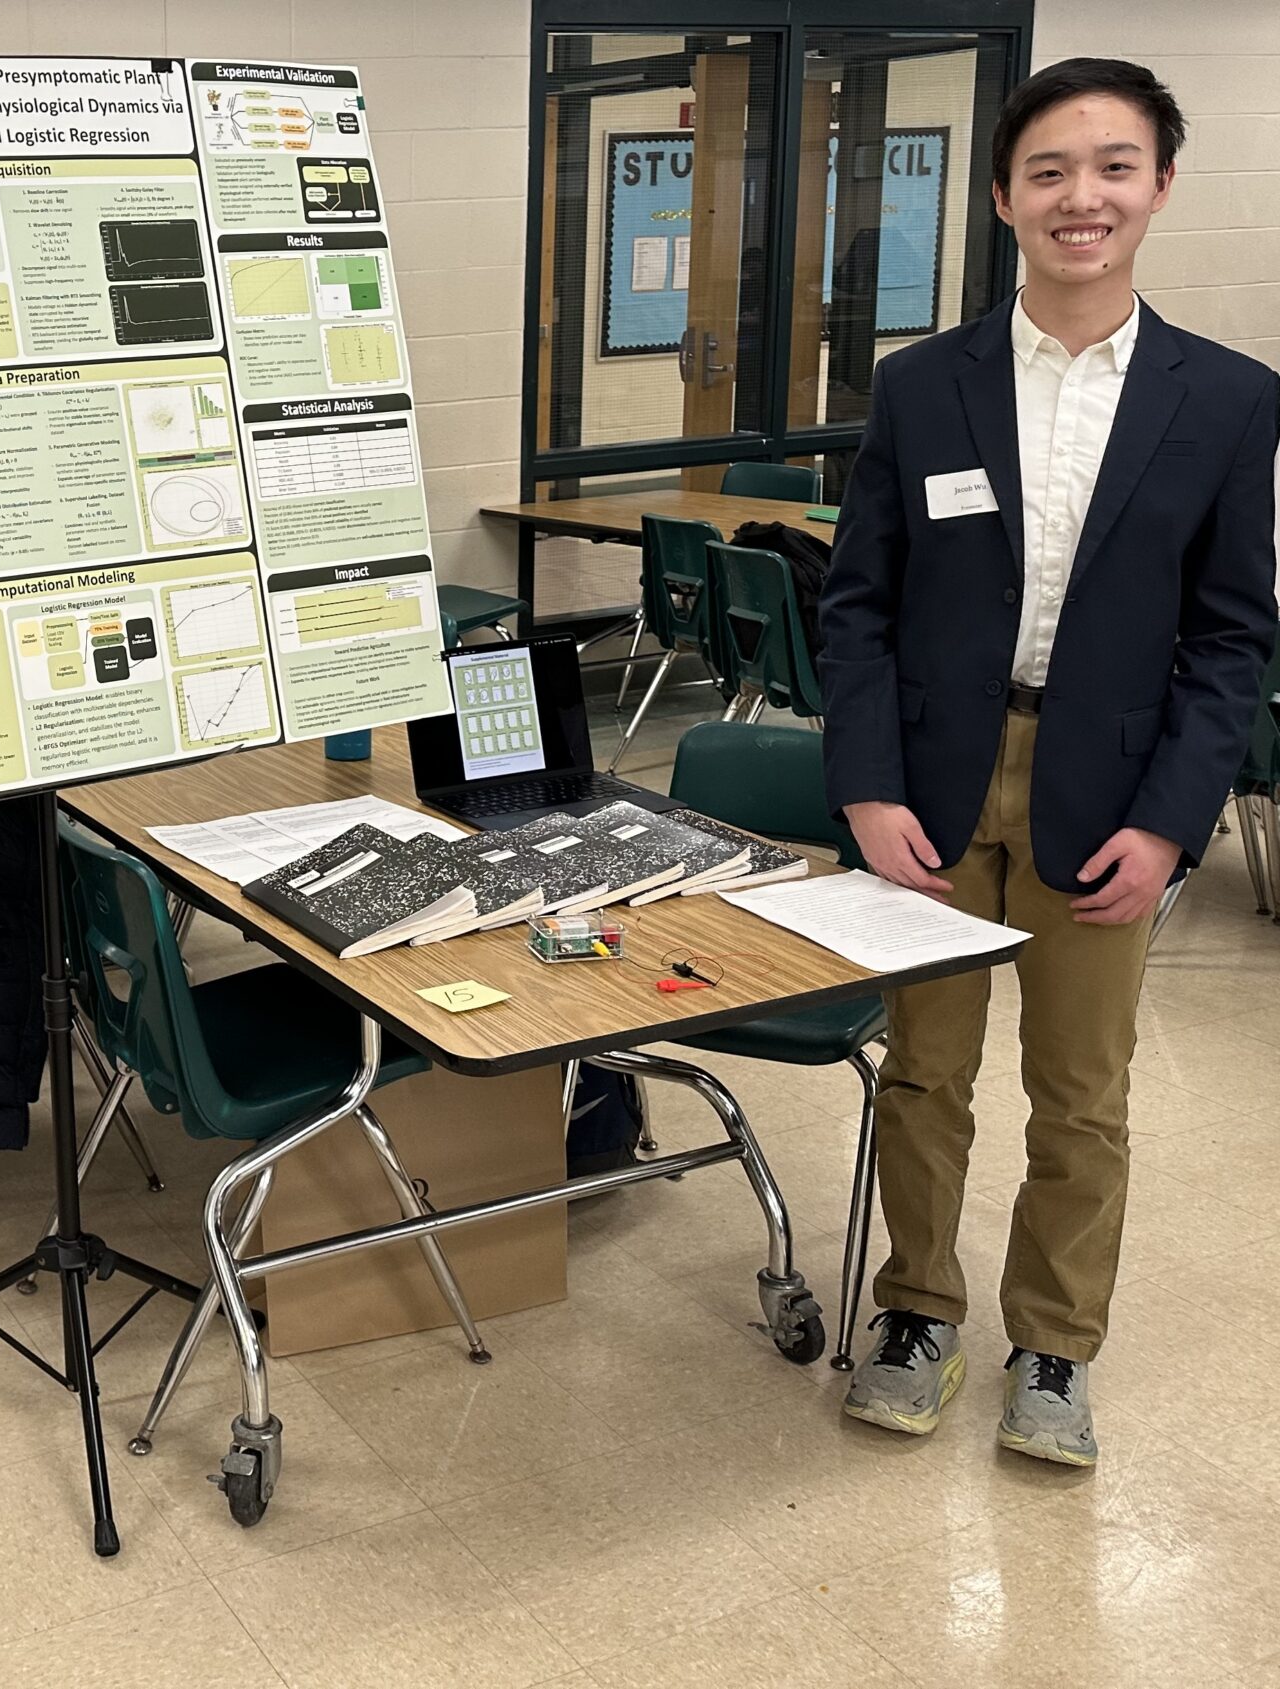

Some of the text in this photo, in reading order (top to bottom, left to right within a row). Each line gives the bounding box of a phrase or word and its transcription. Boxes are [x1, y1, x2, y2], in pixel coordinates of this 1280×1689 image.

[124, 70, 160, 86] Plant
[216, 65, 335, 84] Experimental Validation
[88, 98, 158, 115] Dynamics
[162, 100, 184, 113] via
[6, 128, 65, 146] Logistic
[69, 128, 149, 145] Regression
[623, 143, 932, 186] STU CIL
[286, 235, 323, 246] Results
[6, 368, 80, 385] Preparation
[282, 399, 373, 415] Statistical Analysis
[954, 483, 987, 496] Jacob Wu
[76, 570, 136, 586] Modeling
[334, 566, 369, 580] Impact
[40, 595, 125, 613] Logistic Regression Model
[41, 758, 88, 771] memory efficient
